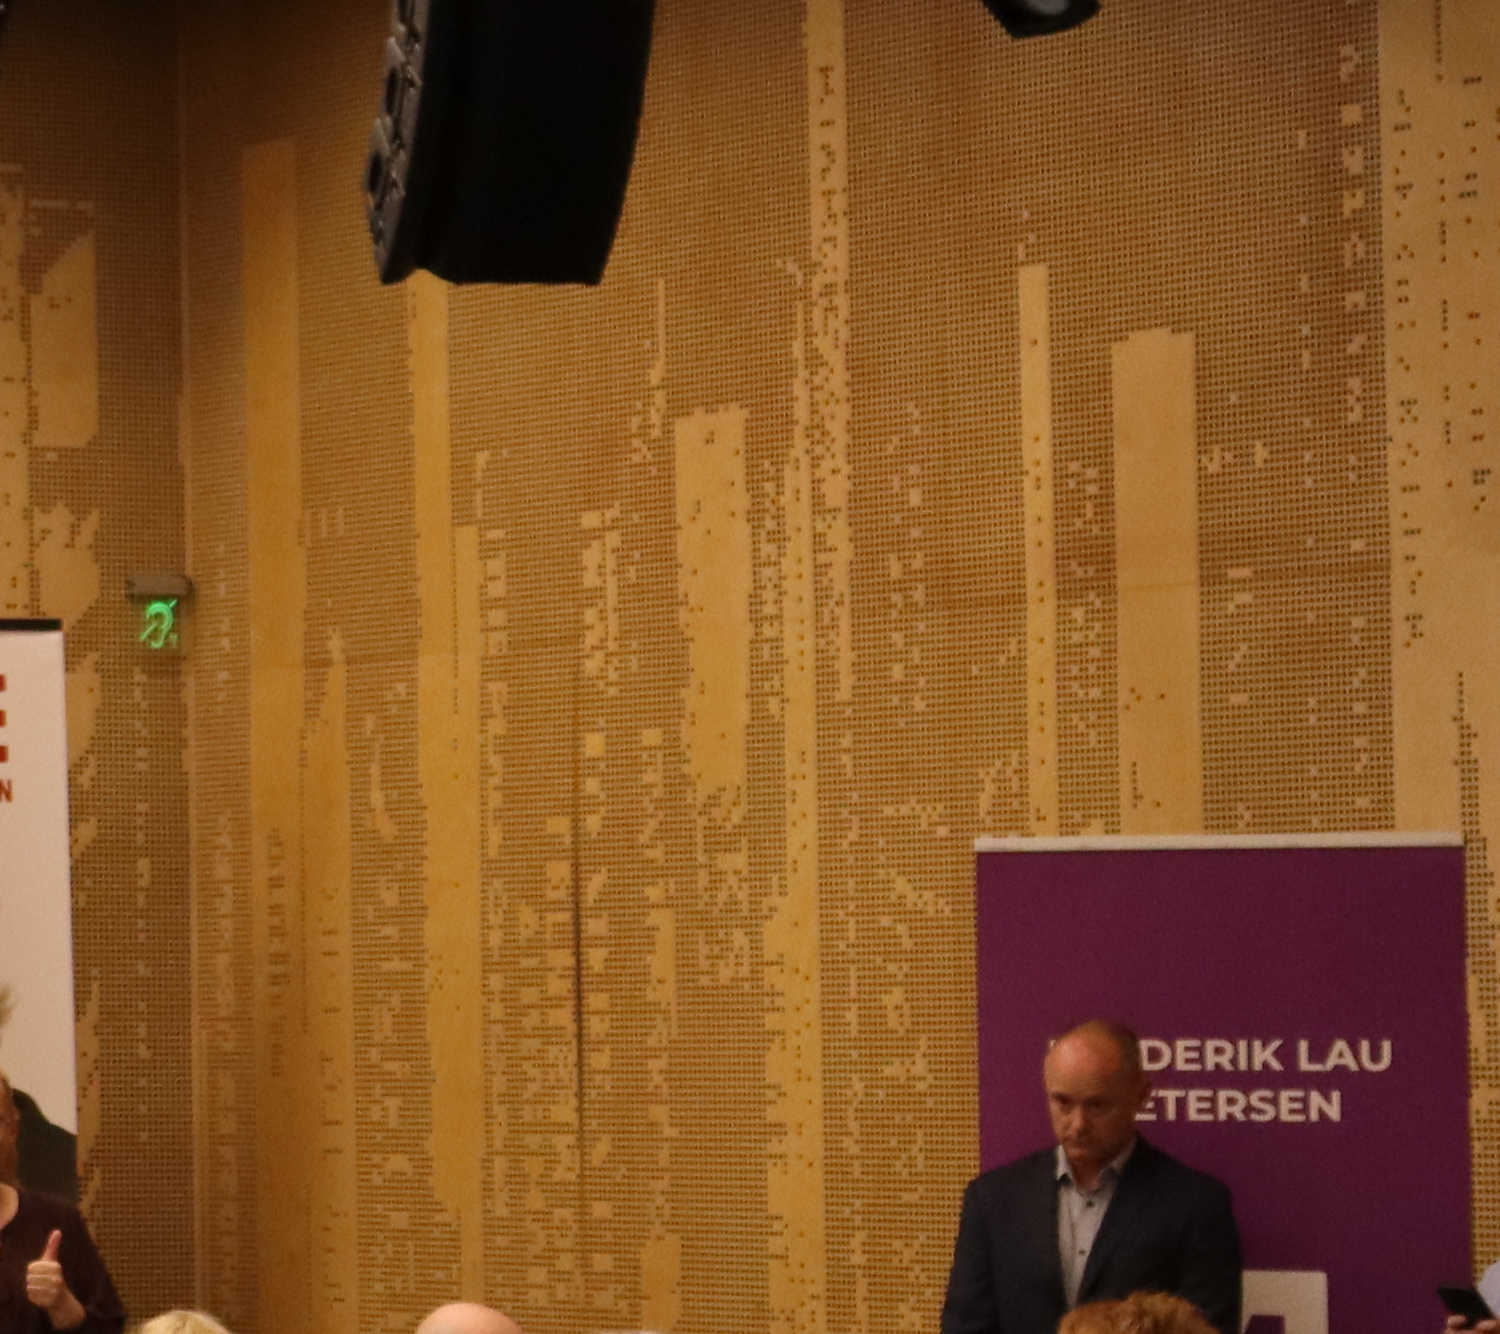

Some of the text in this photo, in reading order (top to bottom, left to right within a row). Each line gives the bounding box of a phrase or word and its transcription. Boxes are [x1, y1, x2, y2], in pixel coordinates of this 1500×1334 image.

[1137, 1038, 1393, 1072] DERIK LAU
[1134, 1088, 1342, 1123] ETERSEN
